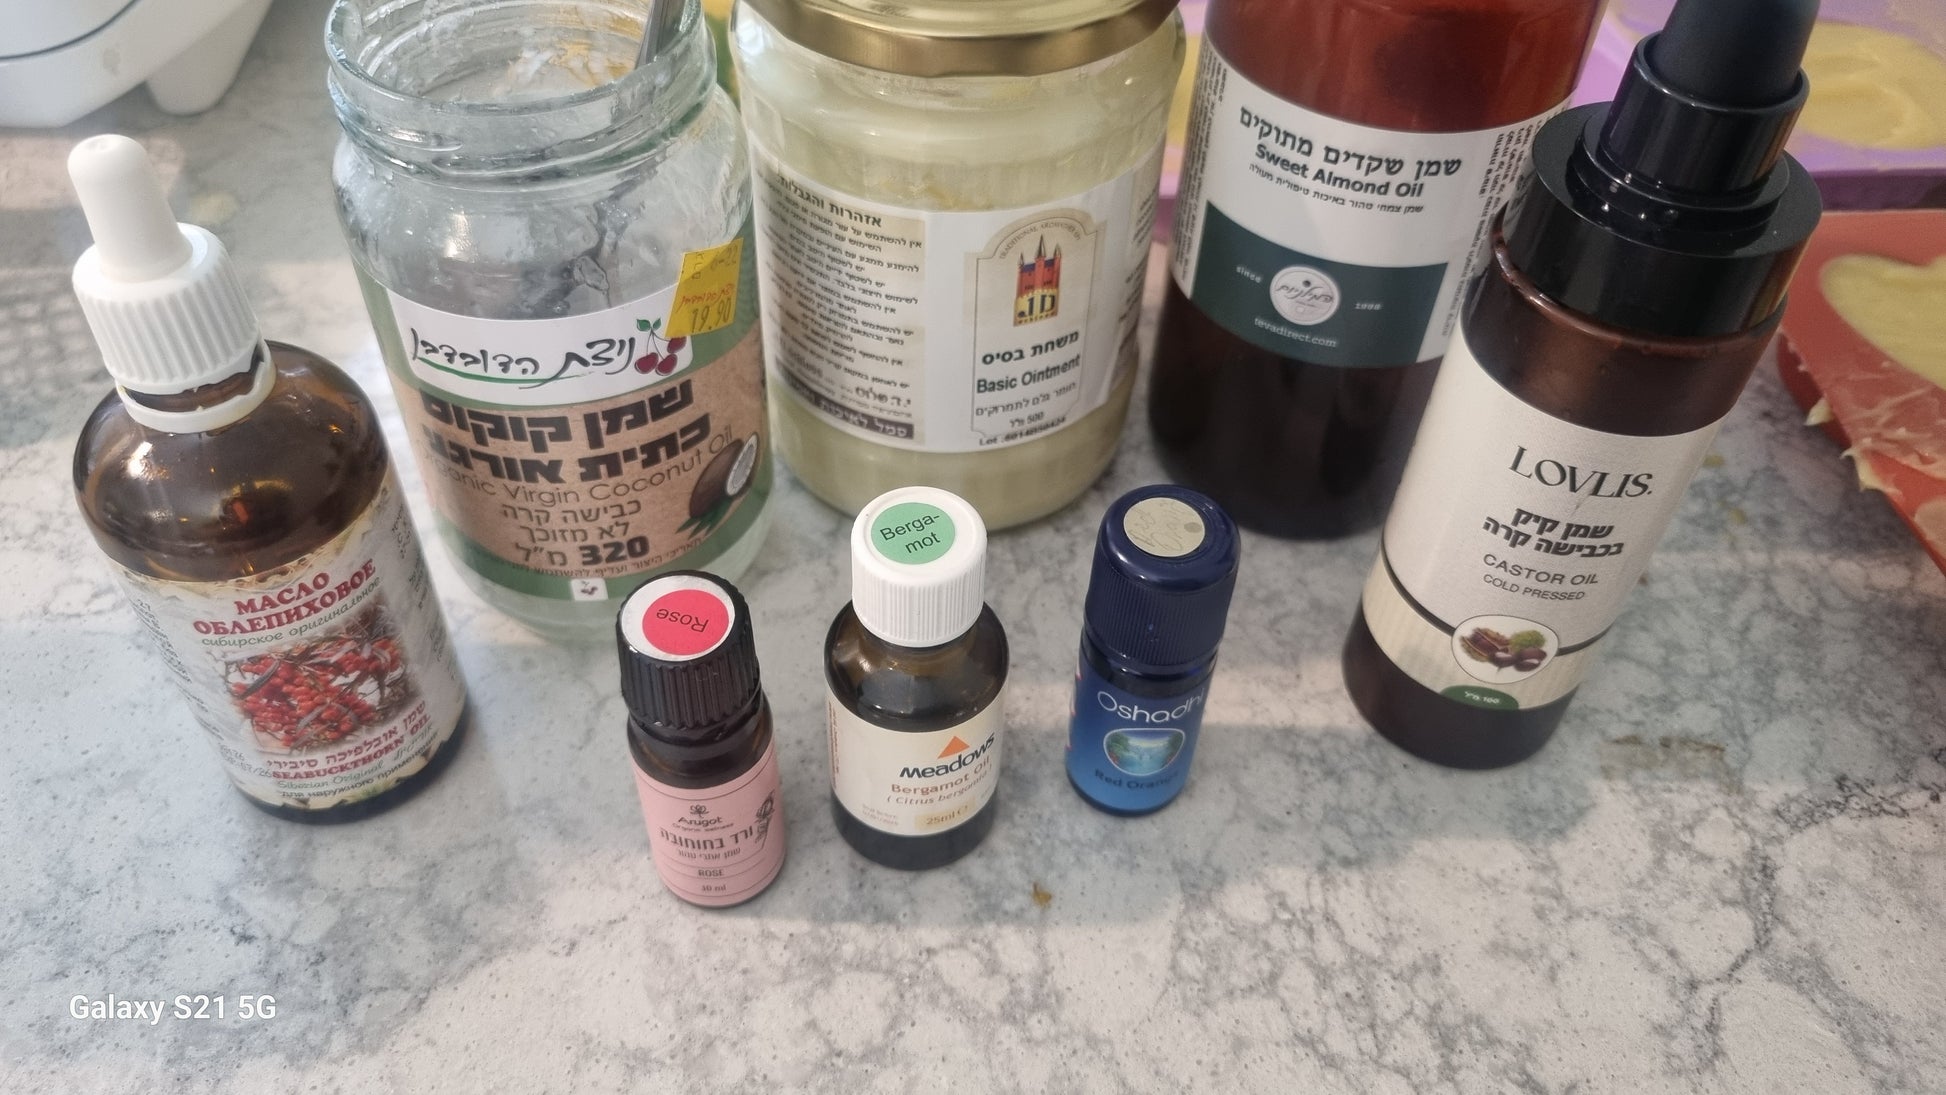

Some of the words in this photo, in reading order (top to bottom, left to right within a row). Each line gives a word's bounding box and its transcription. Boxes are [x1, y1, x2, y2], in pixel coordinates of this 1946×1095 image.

[1240, 106, 1313, 157] מתוקים
[1249, 163, 1273, 181] מעולה
[1255, 143, 1308, 179] Sweet
[1312, 168, 1390, 195] Almond
[1395, 183, 1424, 198] Oil
[1323, 145, 1404, 177] שקדים
[1416, 158, 1462, 180] שמן
[1276, 178, 1311, 196] טיפולית
[1313, 191, 1346, 205] באיכות
[829, 202, 882, 227] אזהרות
[1348, 200, 1373, 210] טהור
[1376, 204, 1401, 213] צמחי
[1403, 205, 1424, 214] שמן
[848, 238, 882, 253] השימוש
[864, 232, 907, 247] להשתמש
[887, 261, 920, 272] להימנע
[1236, 265, 1263, 283] since
[691, 298, 732, 333] 19.90
[1030, 331, 1079, 357] משחת
[1254, 316, 1338, 348] tevadirect.com
[411, 328, 540, 374] הדובדבן
[519, 337, 636, 390] ניצת
[982, 349, 1025, 365] בסיס
[976, 376, 1018, 393] Basic
[1021, 353, 1081, 386] Ointment
[419, 388, 573, 453] קוקוס
[583, 379, 694, 450] שמן
[975, 399, 1030, 417] לתמרוקים
[578, 412, 711, 481] כתית
[503, 482, 580, 508] Virgin
[589, 450, 703, 501] Coconut
[709, 423, 734, 456] Oil
[502, 503, 550, 526] קרה
[562, 500, 642, 524] כבישה
[1511, 508, 1560, 535] קיק
[520, 525, 588, 544] מזוכך
[600, 521, 631, 539] לא
[879, 512, 941, 541] Berga-
[1483, 517, 1532, 549] קרה
[1560, 523, 1615, 541] שמן
[579, 535, 650, 566] 320
[905, 530, 941, 555] mot
[1533, 537, 1625, 559] בכבישה
[1483, 553, 1566, 586] CASTOR
[1570, 573, 1599, 587] OIL
[193, 558, 377, 636] ОБЛЕПИХОВОЕ
[235, 572, 331, 616] МАСЛО
[1483, 573, 1519, 594] COLD
[1522, 586, 1586, 601] PRESSED
[201, 629, 285, 649] сибирское
[288, 575, 381, 639] оригинальное
[656, 607, 710, 633] Rose
[403, 700, 427, 733] שמן
[272, 736, 405, 781] SEABUCKTHORN
[410, 712, 432, 738] OIL
[326, 727, 399, 763] אובלפיכה
[899, 731, 996, 779] Meadows
[266, 756, 319, 773] סיבירי
[333, 761, 386, 784] Original
[891, 773, 970, 796] Bergamot
[974, 757, 990, 777] Oil
[307, 777, 375, 799] наружного
[1094, 768, 1123, 788] Red
[895, 794, 934, 805] Citrus
[678, 816, 724, 827] Arugot
[729, 826, 754, 844] ורד
[697, 869, 726, 878] ROSE
